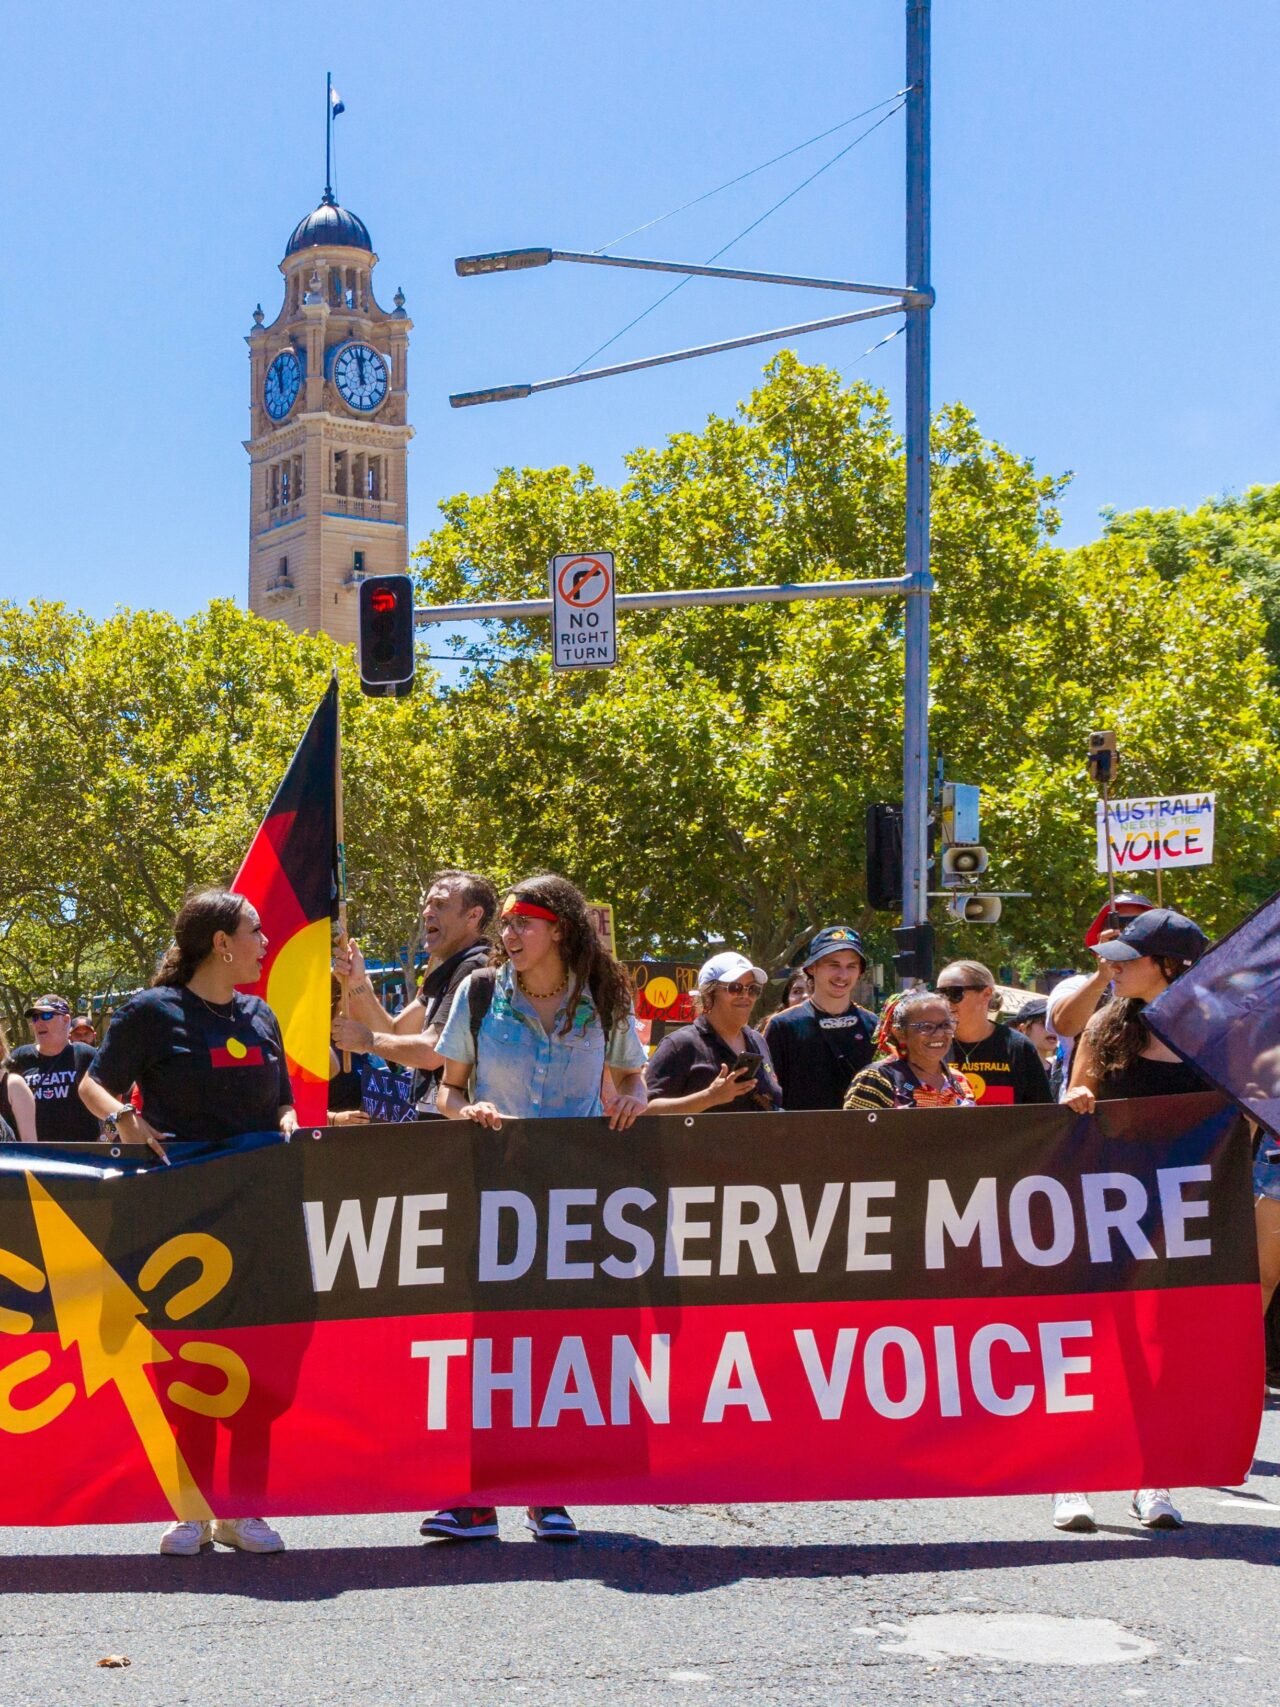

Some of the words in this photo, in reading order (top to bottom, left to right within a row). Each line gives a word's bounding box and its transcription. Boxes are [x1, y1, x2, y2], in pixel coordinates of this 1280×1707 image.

[569, 612, 599, 629] NO
[561, 631, 609, 645] RIGHT
[563, 647, 608, 660] TURN
[1102, 796, 1212, 823] AUSTRALIA
[1109, 828, 1204, 866] VOICE
[675, 966, 700, 992] PRID
[654, 989, 669, 1004] IN
[24, 1070, 77, 1085] TREATY
[961, 1062, 1011, 1072] AUSTRALIA
[367, 1074, 411, 1103] ALW
[303, 1193, 448, 1292] WE
[479, 1181, 896, 1282] DESERVE
[925, 1164, 1212, 1270] MORE
[411, 1333, 671, 1432] THAN
[703, 1332, 772, 1423] A
[794, 1320, 1094, 1420] VOICE
